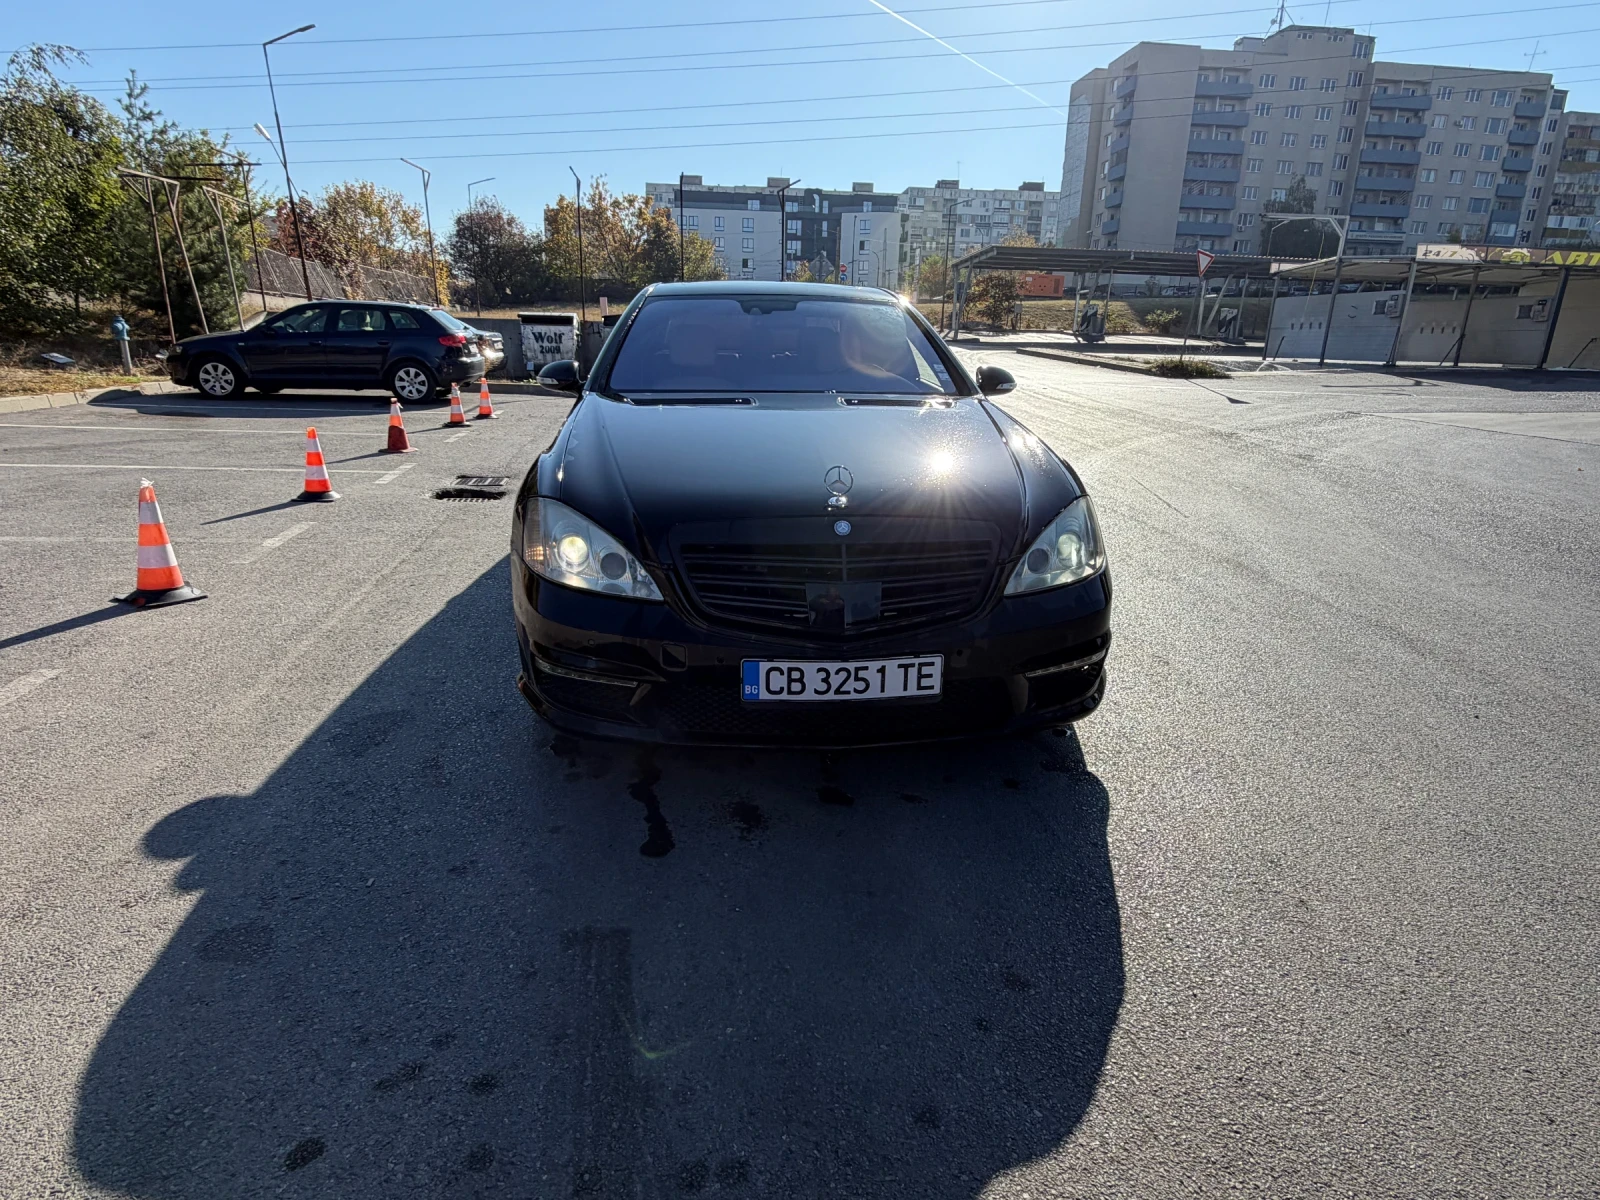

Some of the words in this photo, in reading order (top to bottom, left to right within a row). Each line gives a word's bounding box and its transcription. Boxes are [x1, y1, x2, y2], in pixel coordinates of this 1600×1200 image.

[1422, 250, 1458, 258] 24/7
[532, 331, 564, 344] Wolf
[765, 666, 806, 695] CB
[814, 665, 887, 695] 3251
[897, 661, 935, 692] TE
[744, 685, 758, 694] BG
